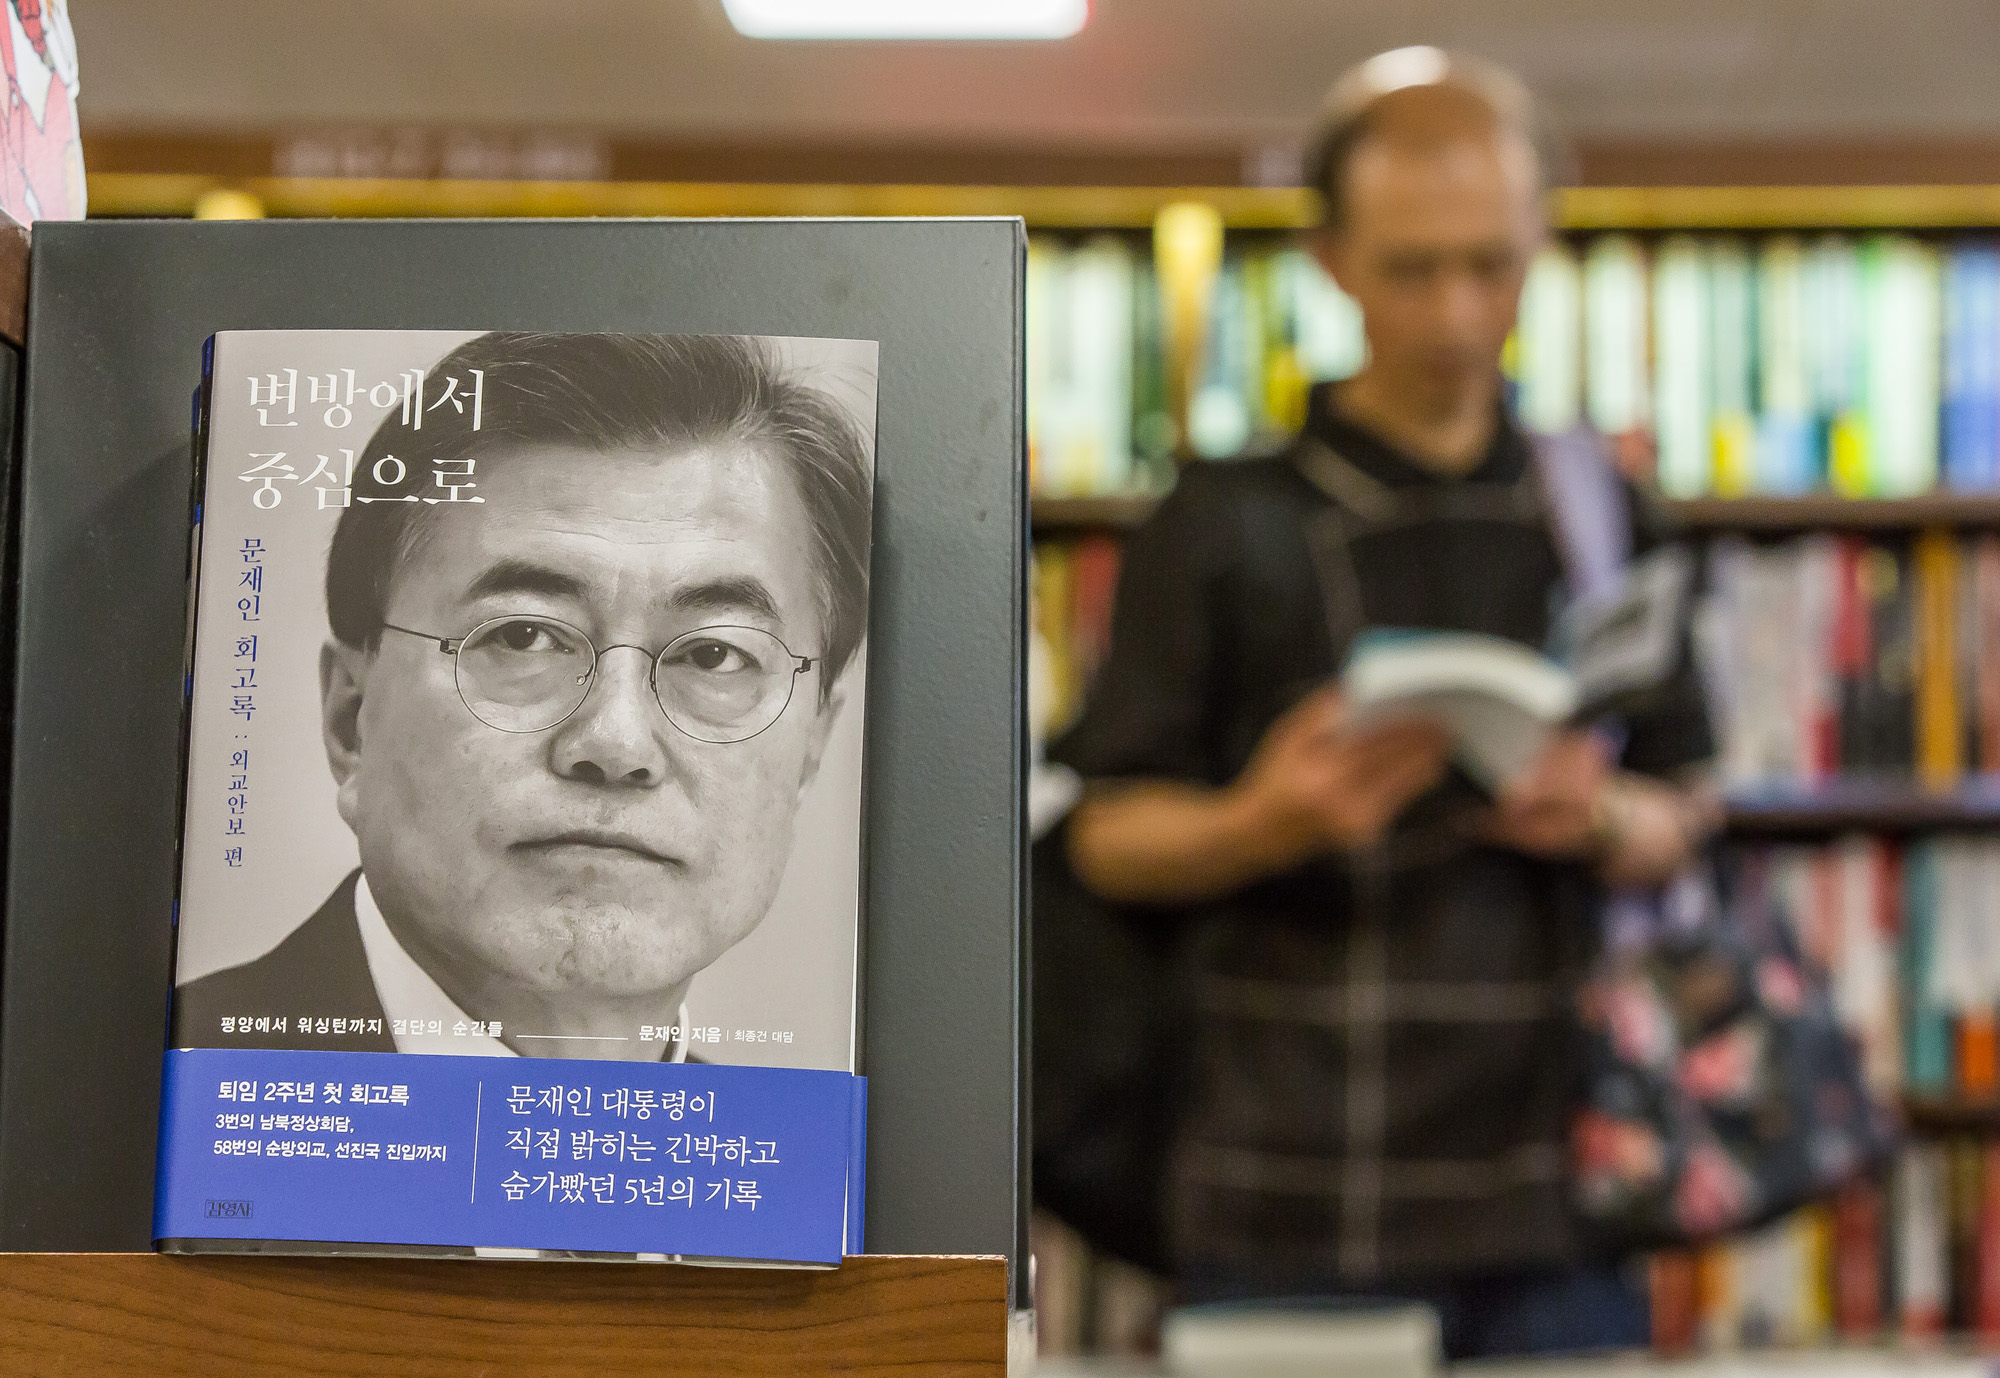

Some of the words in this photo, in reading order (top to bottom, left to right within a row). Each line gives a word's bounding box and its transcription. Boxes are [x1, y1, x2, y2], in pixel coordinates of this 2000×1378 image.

[247, 368, 484, 431] 변방에서
[238, 449, 485, 510] 중심으로
[238, 538, 266, 622] 문재인
[229, 635, 258, 721] 회고록
[225, 750, 249, 835] 외교안보
[224, 847, 243, 868] 편
[220, 1016, 287, 1033] 평양에서
[297, 1017, 382, 1035] 워싱턴까지
[392, 1019, 443, 1036] 결단의
[452, 1020, 503, 1038] 순간들
[639, 1025, 685, 1043] 문재인
[691, 1027, 722, 1043] 지음
[734, 1029, 767, 1043] 최종건
[771, 1031, 794, 1043] 대담
[218, 1080, 257, 1102] 퇴임
[264, 1082, 315, 1104] 2주년
[322, 1082, 343, 1105] 첫
[349, 1083, 410, 1106] 회고록
[506, 1084, 592, 1118] 문재인
[601, 1088, 715, 1123] 대통령이
[215, 1113, 255, 1130] 3번의
[260, 1114, 355, 1134] 남북정상회담,
[213, 1139, 261, 1157] 58번의
[265, 1140, 330, 1160] 순방외교,
[334, 1142, 380, 1160] 선진국
[386, 1143, 447, 1162] 진입까지
[504, 1126, 561, 1160] 직접
[570, 1128, 657, 1163] 밝히는
[664, 1133, 781, 1168] 긴박하고
[208, 1201, 250, 1217] 김영사
[500, 1170, 615, 1205] 숨가빴던
[624, 1174, 695, 1209] 5년의
[705, 1178, 762, 1211] 기록
